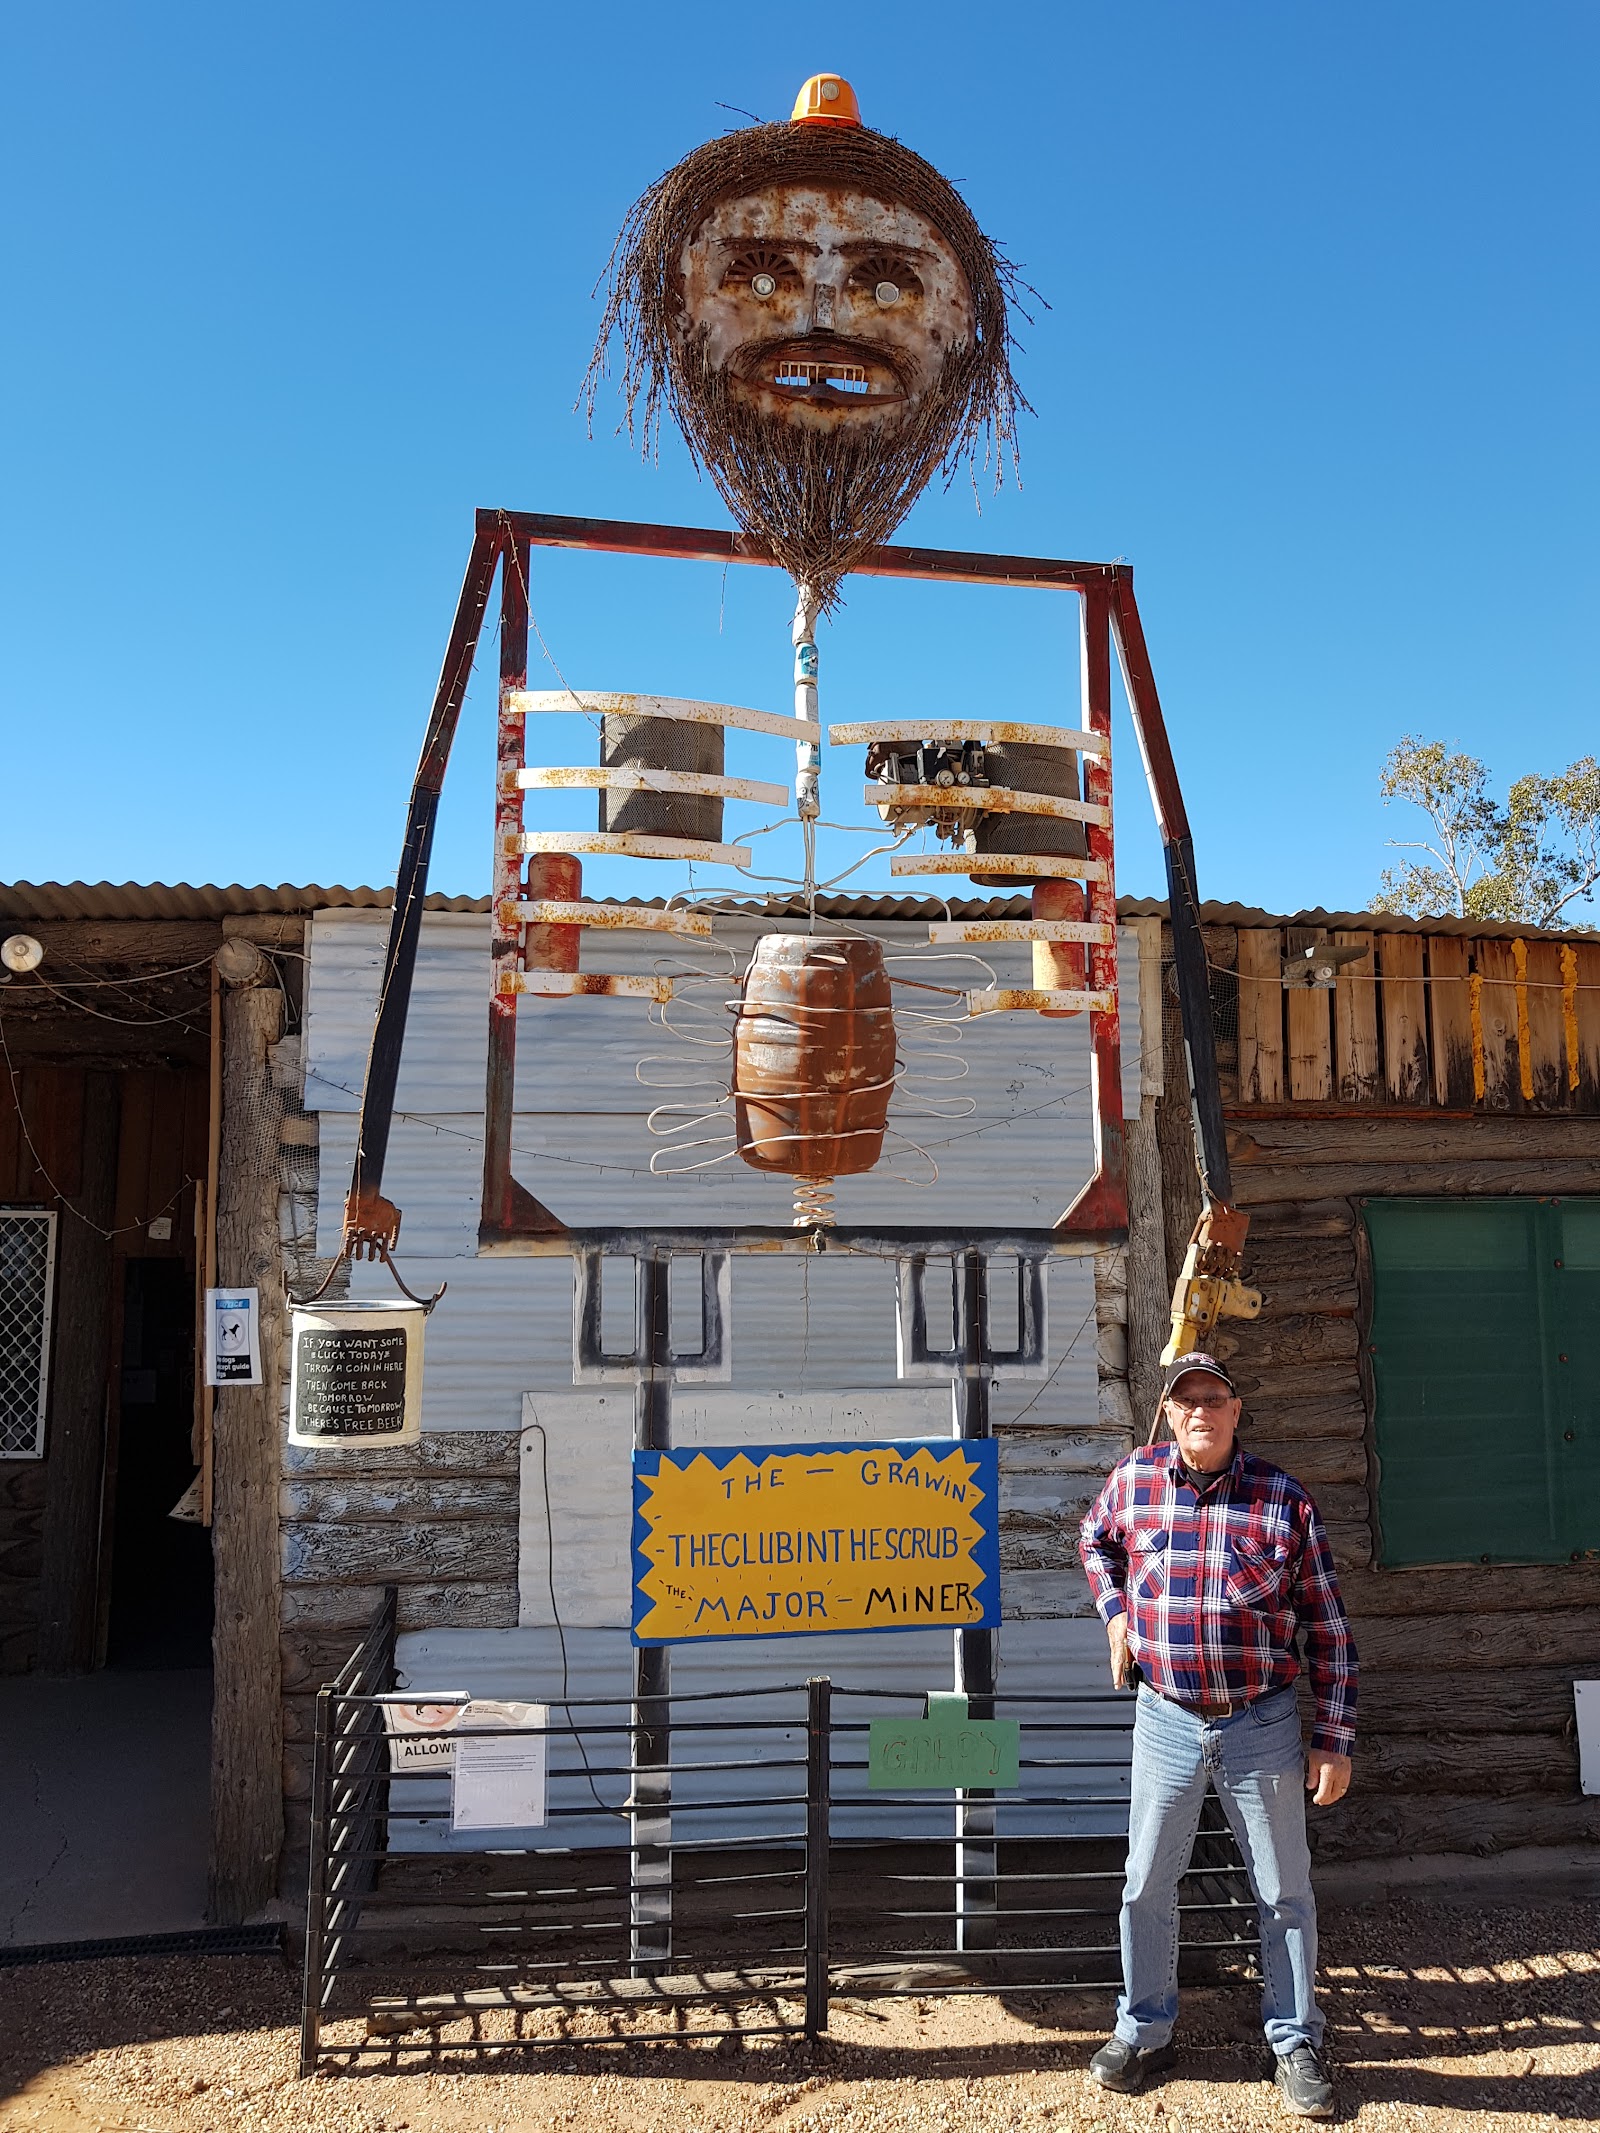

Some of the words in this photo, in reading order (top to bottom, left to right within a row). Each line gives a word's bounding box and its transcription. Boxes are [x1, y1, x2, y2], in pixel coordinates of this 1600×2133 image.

[303, 1337, 314, 1348] IF
[344, 1339, 378, 1348] WANT
[380, 1337, 404, 1346] SOME
[231, 1362, 250, 1371] guide
[304, 1363, 334, 1373] THROW
[336, 1363, 343, 1372] A
[383, 1362, 404, 1371] HERE
[306, 1380, 328, 1391] THEN
[330, 1380, 358, 1391] COME
[361, 1380, 387, 1389] BACK
[317, 1393, 374, 1402] TOMORROW
[308, 1403, 354, 1414] BECAUSE
[355, 1401, 402, 1414] TOMORROW
[303, 1416, 340, 1429] THERE'S
[344, 1418, 374, 1431] FREE
[377, 1416, 403, 1430] BEER
[721, 1468, 785, 1499] THE
[665, 1585, 686, 1599] THE
[694, 1590, 828, 1623] MAJOR
[405, 1742, 457, 1757] ALLOWE
